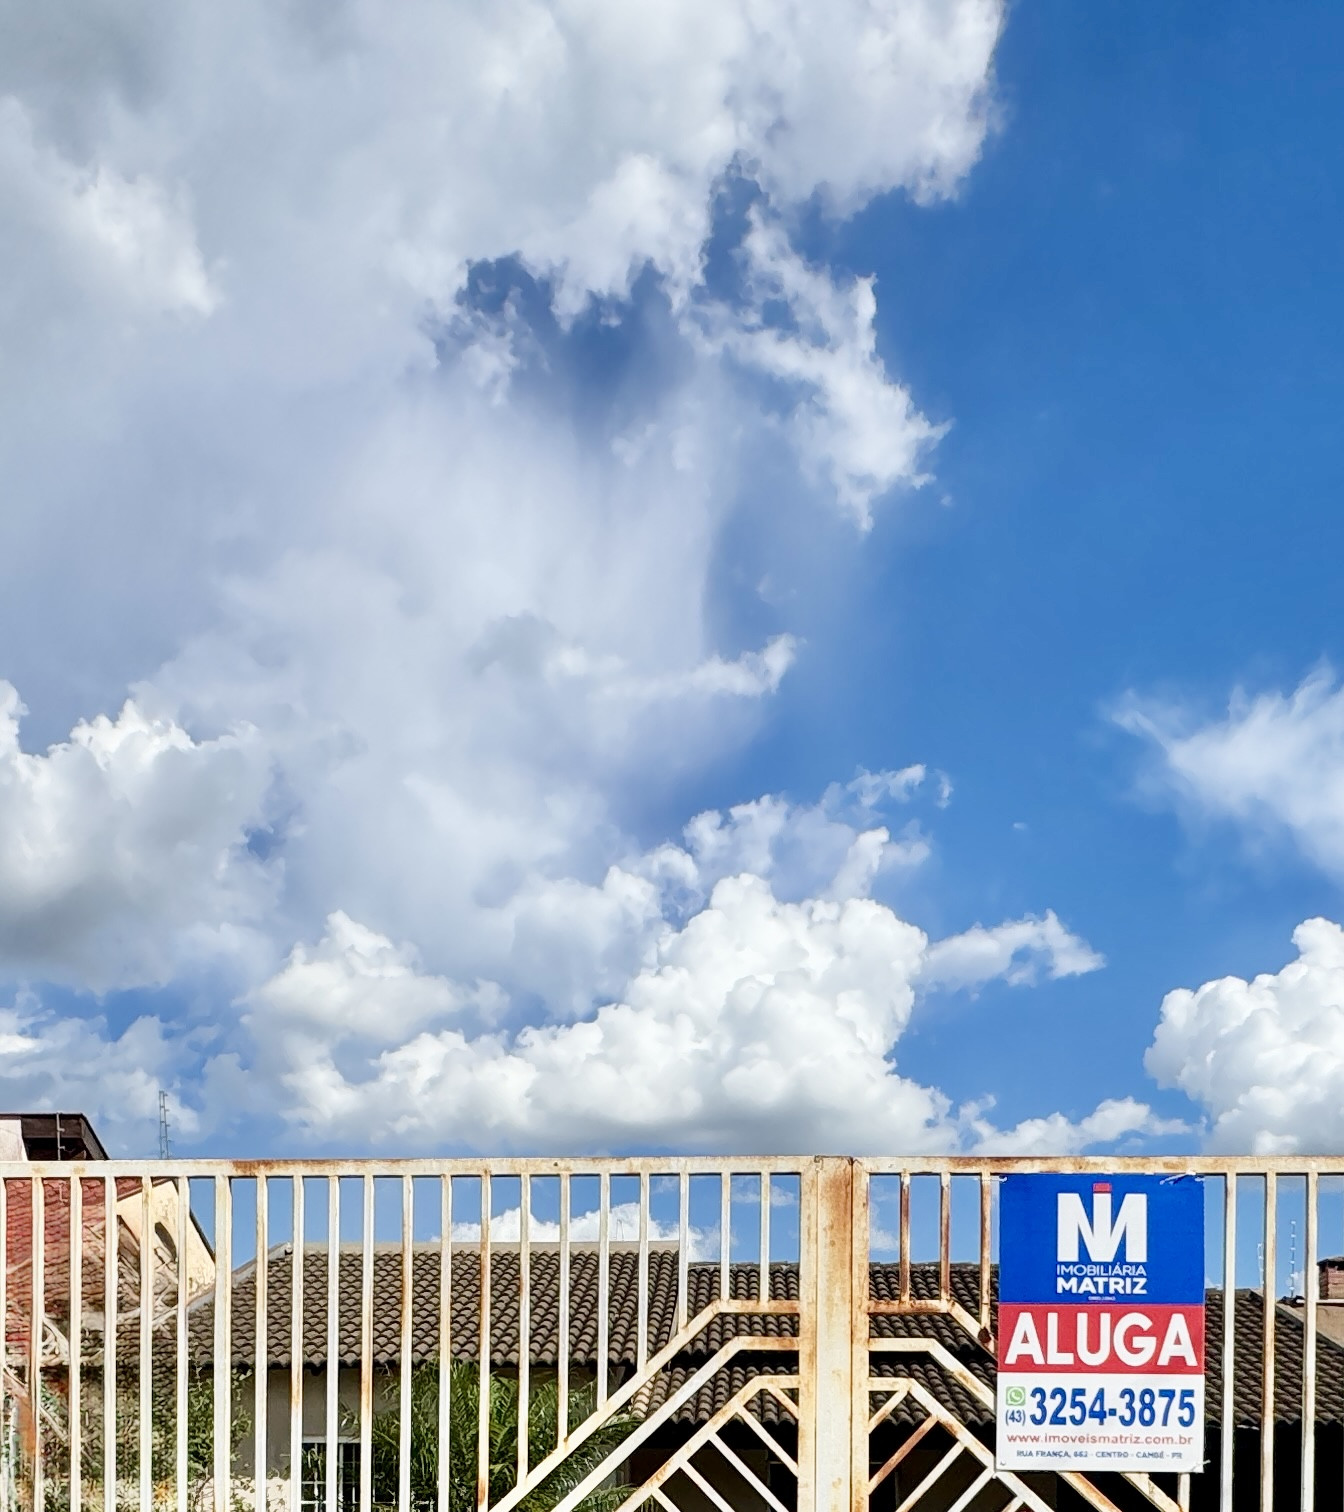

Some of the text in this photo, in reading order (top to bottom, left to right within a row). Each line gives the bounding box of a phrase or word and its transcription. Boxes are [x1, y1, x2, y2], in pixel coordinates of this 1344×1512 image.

[1057, 1262, 1146, 1276] IMOBILIÁRIA
[1057, 1277, 1147, 1294] MATRIZ
[1005, 1312, 1198, 1367] ALUGA
[1006, 1387, 1196, 1427] (43) 3254-3875
[1007, 1433, 1193, 1445] www.imoveismatriz.com.br
[1016, 1450, 1034, 1458] RUA
